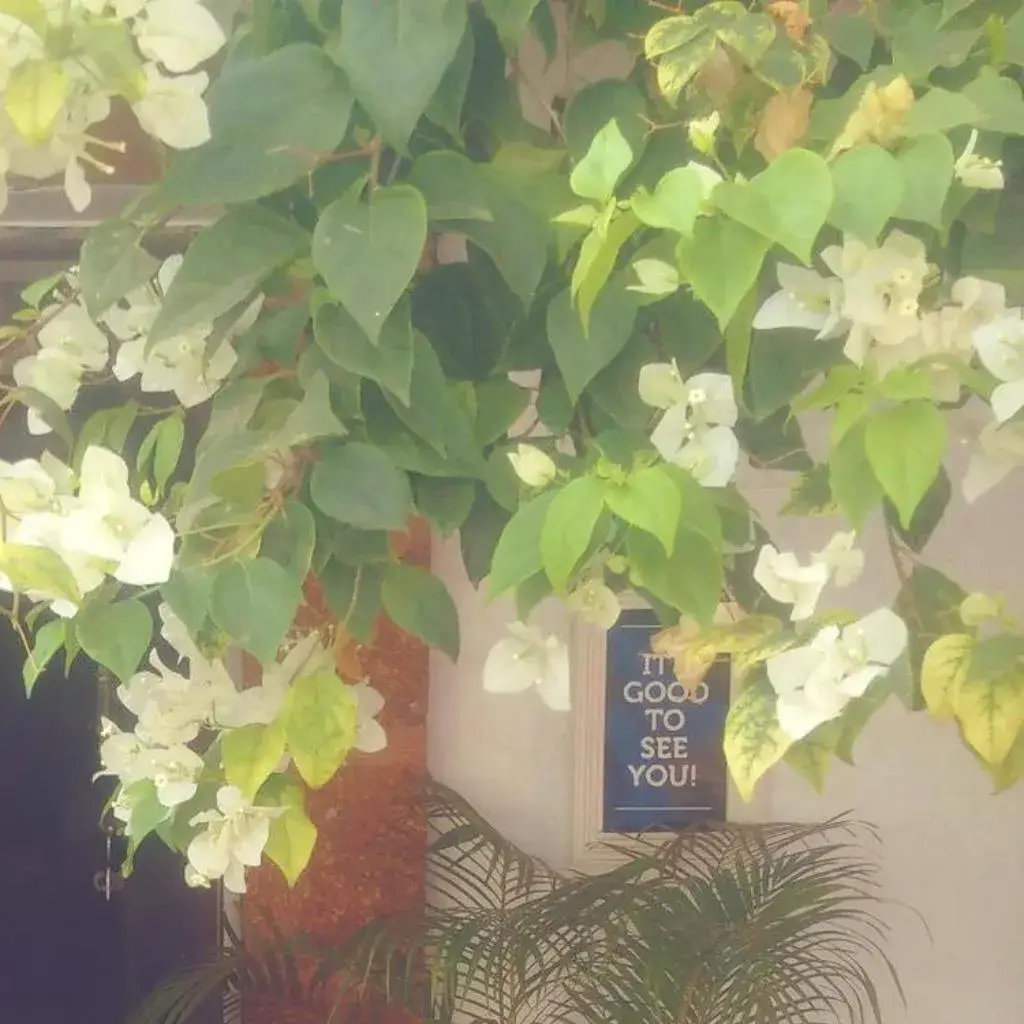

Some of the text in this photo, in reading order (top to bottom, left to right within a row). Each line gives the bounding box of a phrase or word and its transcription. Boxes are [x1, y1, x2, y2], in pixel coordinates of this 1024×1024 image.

[645, 708, 685, 731] TO
[640, 736, 688, 759] SEE
[628, 764, 696, 787] YOU!
